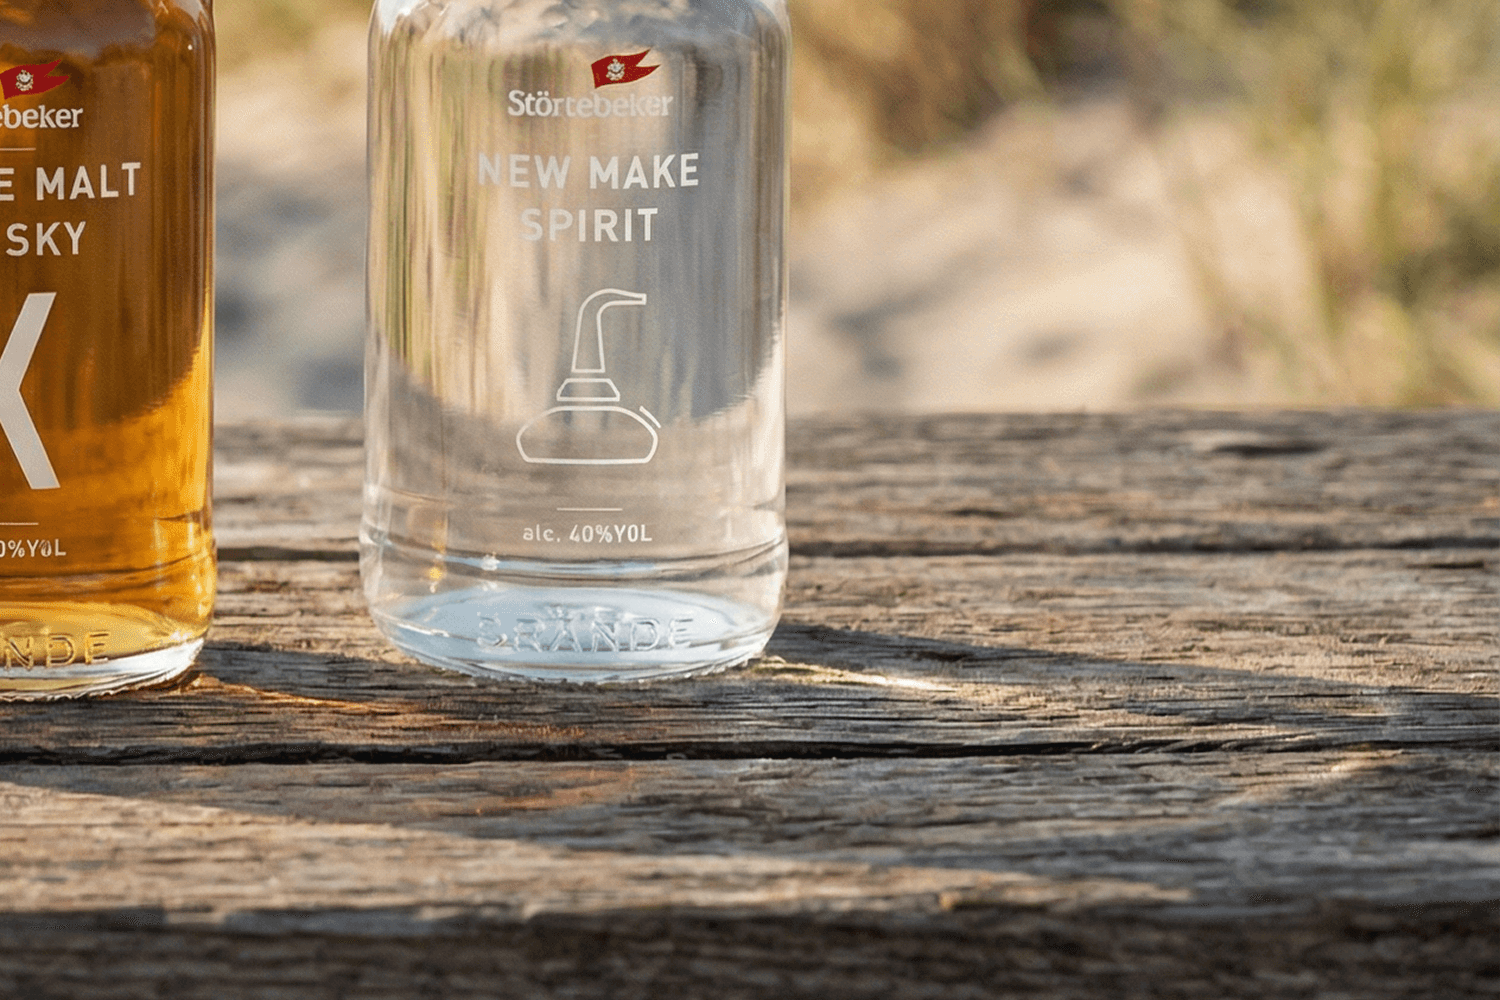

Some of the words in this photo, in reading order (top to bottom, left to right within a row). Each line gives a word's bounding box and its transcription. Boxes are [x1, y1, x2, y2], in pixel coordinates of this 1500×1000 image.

[507, 89, 674, 118] Störtebeker
[35, 161, 141, 201] MALT
[477, 152, 571, 189] NEW
[589, 152, 699, 190] MAKE
[520, 207, 658, 243] SPIRIT
[522, 523, 561, 542] alc.
